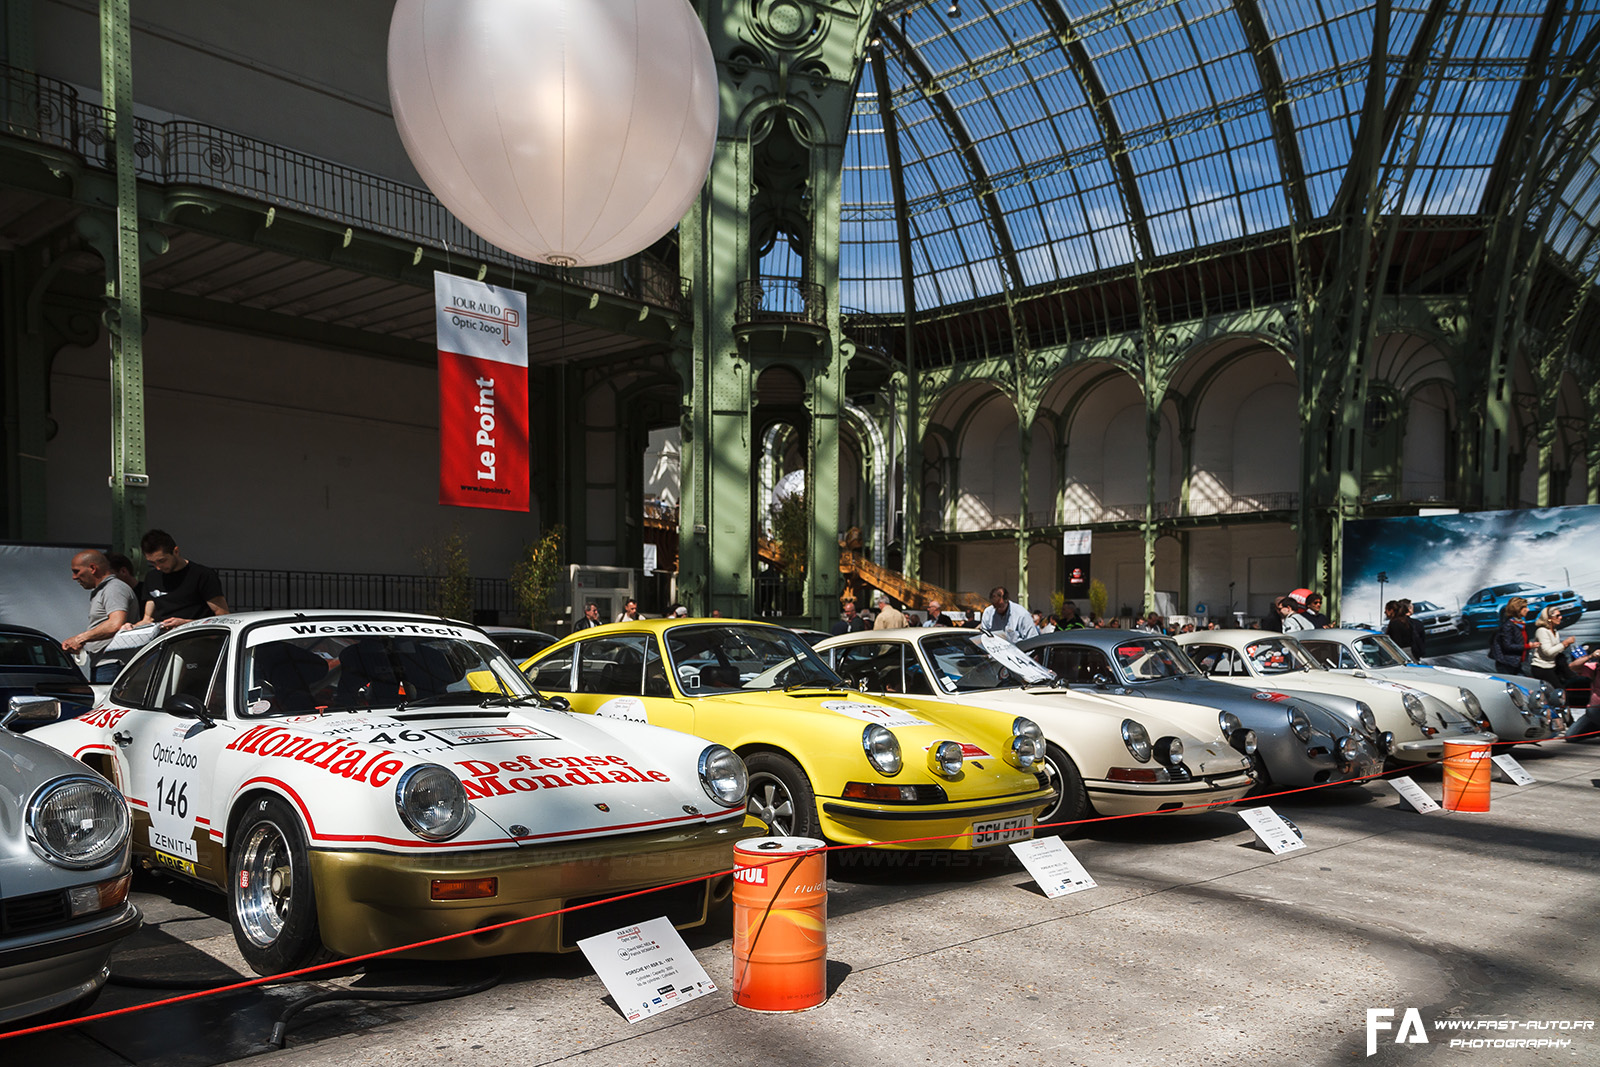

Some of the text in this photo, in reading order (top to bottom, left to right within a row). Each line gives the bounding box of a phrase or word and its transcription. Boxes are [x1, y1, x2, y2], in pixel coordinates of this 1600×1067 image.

[452, 296, 501, 316] TOUR AUTO
[452, 316, 502, 335] Optic 2000
[474, 377, 496, 481] Le Point
[460, 485, 511, 495] www.lepoint.fr
[291, 624, 462, 637] WeatherTech
[862, 705, 891, 717] 17
[153, 742, 198, 770] Optic 2000
[226, 724, 404, 788] Mondiale
[454, 755, 628, 777] Defense
[461, 766, 671, 800] Mondiale
[156, 776, 188, 819] 146
[977, 815, 1029, 843] SCW 574L
[155, 832, 192, 856] ZENITH
